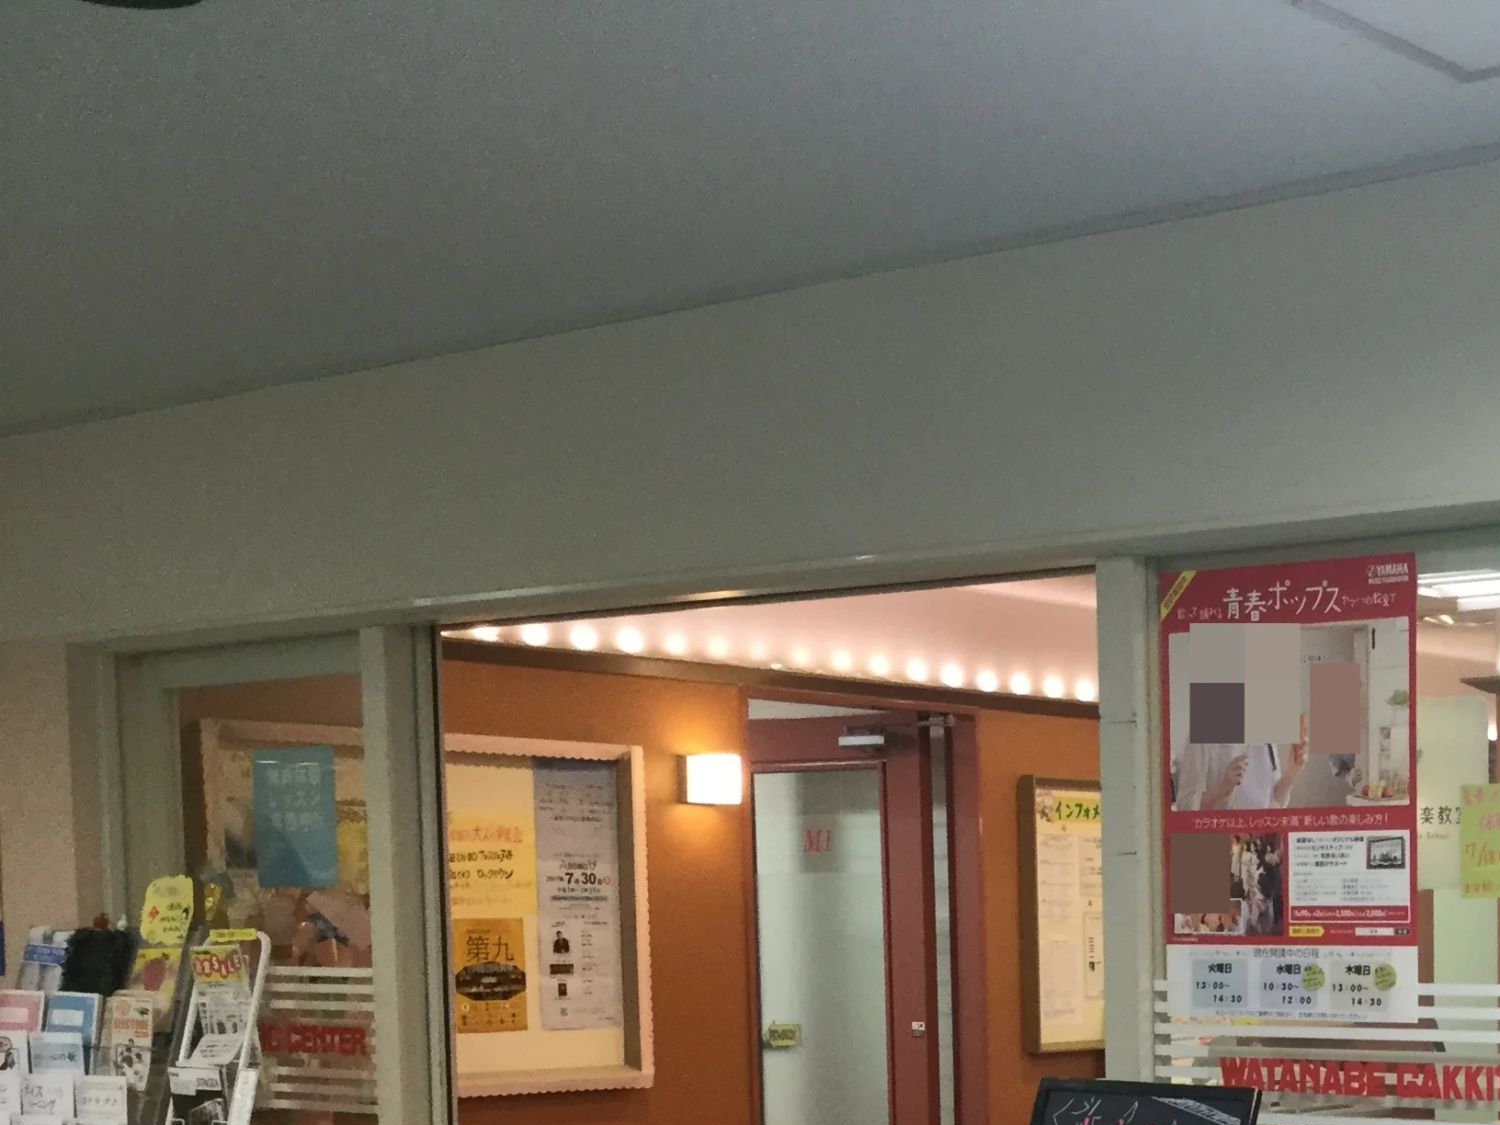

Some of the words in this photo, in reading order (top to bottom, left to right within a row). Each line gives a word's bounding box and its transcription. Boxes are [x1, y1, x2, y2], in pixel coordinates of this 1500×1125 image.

[1376, 563, 1409, 576] YAMAHA
[1223, 579, 1342, 622] 青春ポップス
[465, 935, 516, 962] 第九
[1208, 964, 1233, 974] 火曜日
[1219, 1056, 1388, 1098] WATANABE
